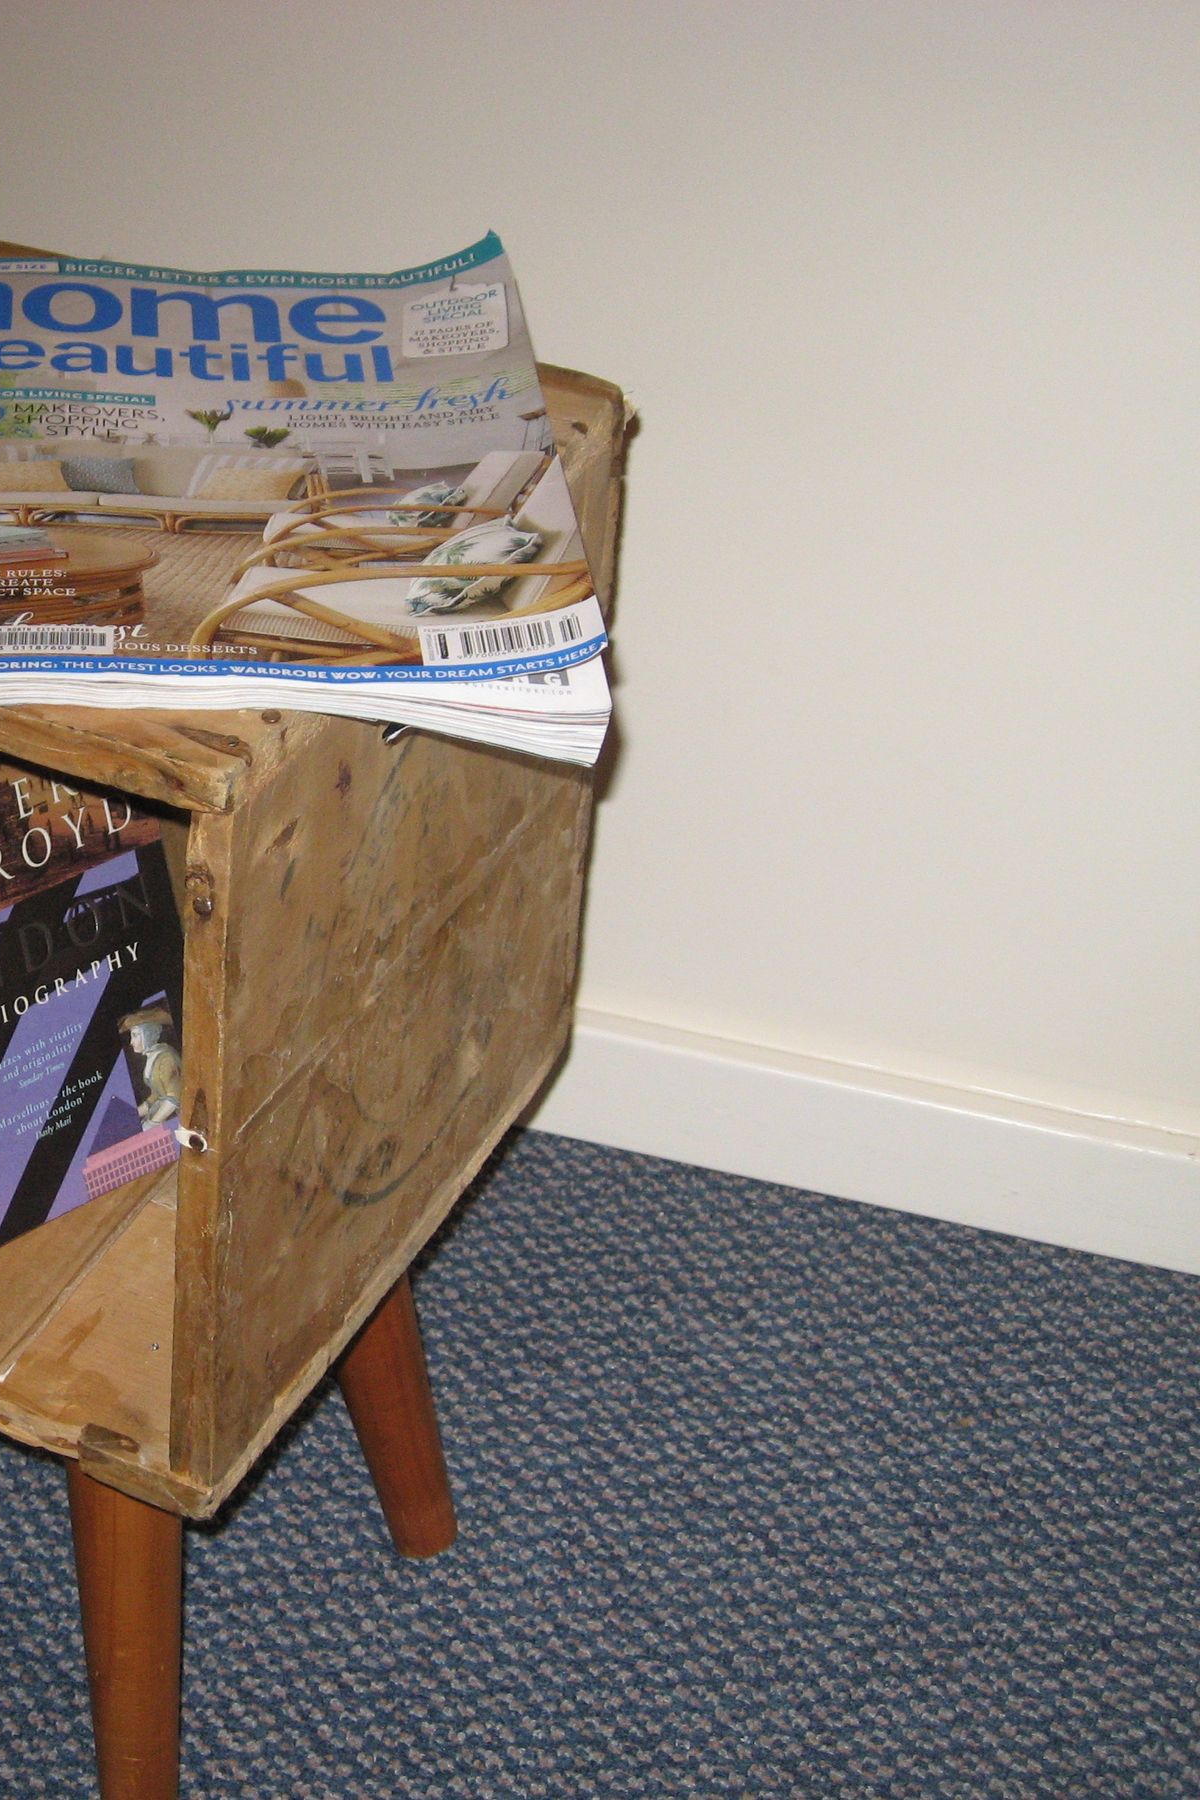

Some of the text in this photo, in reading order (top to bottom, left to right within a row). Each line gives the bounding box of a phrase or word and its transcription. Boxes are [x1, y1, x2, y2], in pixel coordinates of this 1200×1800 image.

[65, 254, 475, 286] BIGGER, BETTER & EVEN MORE BEAUTIFUL!
[409, 289, 498, 311] OUTDOOR
[423, 309, 486, 323] SPECIAL
[427, 302, 483, 316] LIVING
[418, 336, 490, 348] SHOPPING
[438, 342, 486, 353] STYLE
[29, 390, 83, 400] LIVING
[87, 393, 151, 404] SPECIAL
[227, 377, 514, 414] summer fresh
[14, 403, 166, 422] MAKEOVERS,
[288, 405, 496, 422] LIGHT, BRIGHT AND AIRY
[13, 414, 139, 430] SHOPPING
[401, 420, 441, 429] EASY
[447, 413, 501, 426] STYLE
[46, 425, 119, 440] STYLE
[6, 569, 68, 579] RULES:
[23, 588, 78, 597] SPACE
[166, 644, 258, 655] DESSERTS
[62, 660, 95, 670] THE
[98, 662, 156, 671] LATEST
[160, 664, 217, 673] LOOKS
[230, 666, 328, 679] WARDROBE
[331, 671, 381, 680] WOW:
[385, 670, 433, 679] YOUR
[435, 667, 493, 678] DREAM
[497, 657, 555, 674] STARTS
[24, 1038, 46, 1057] with
[48, 1022, 84, 1045] vitality
[2, 1067, 20, 1083] and
[61, 1083, 77, 1098] the
[78, 1069, 104, 1089] book
[16, 1116, 44, 1137] about
[35, 1114, 73, 1142] Daily Mail
